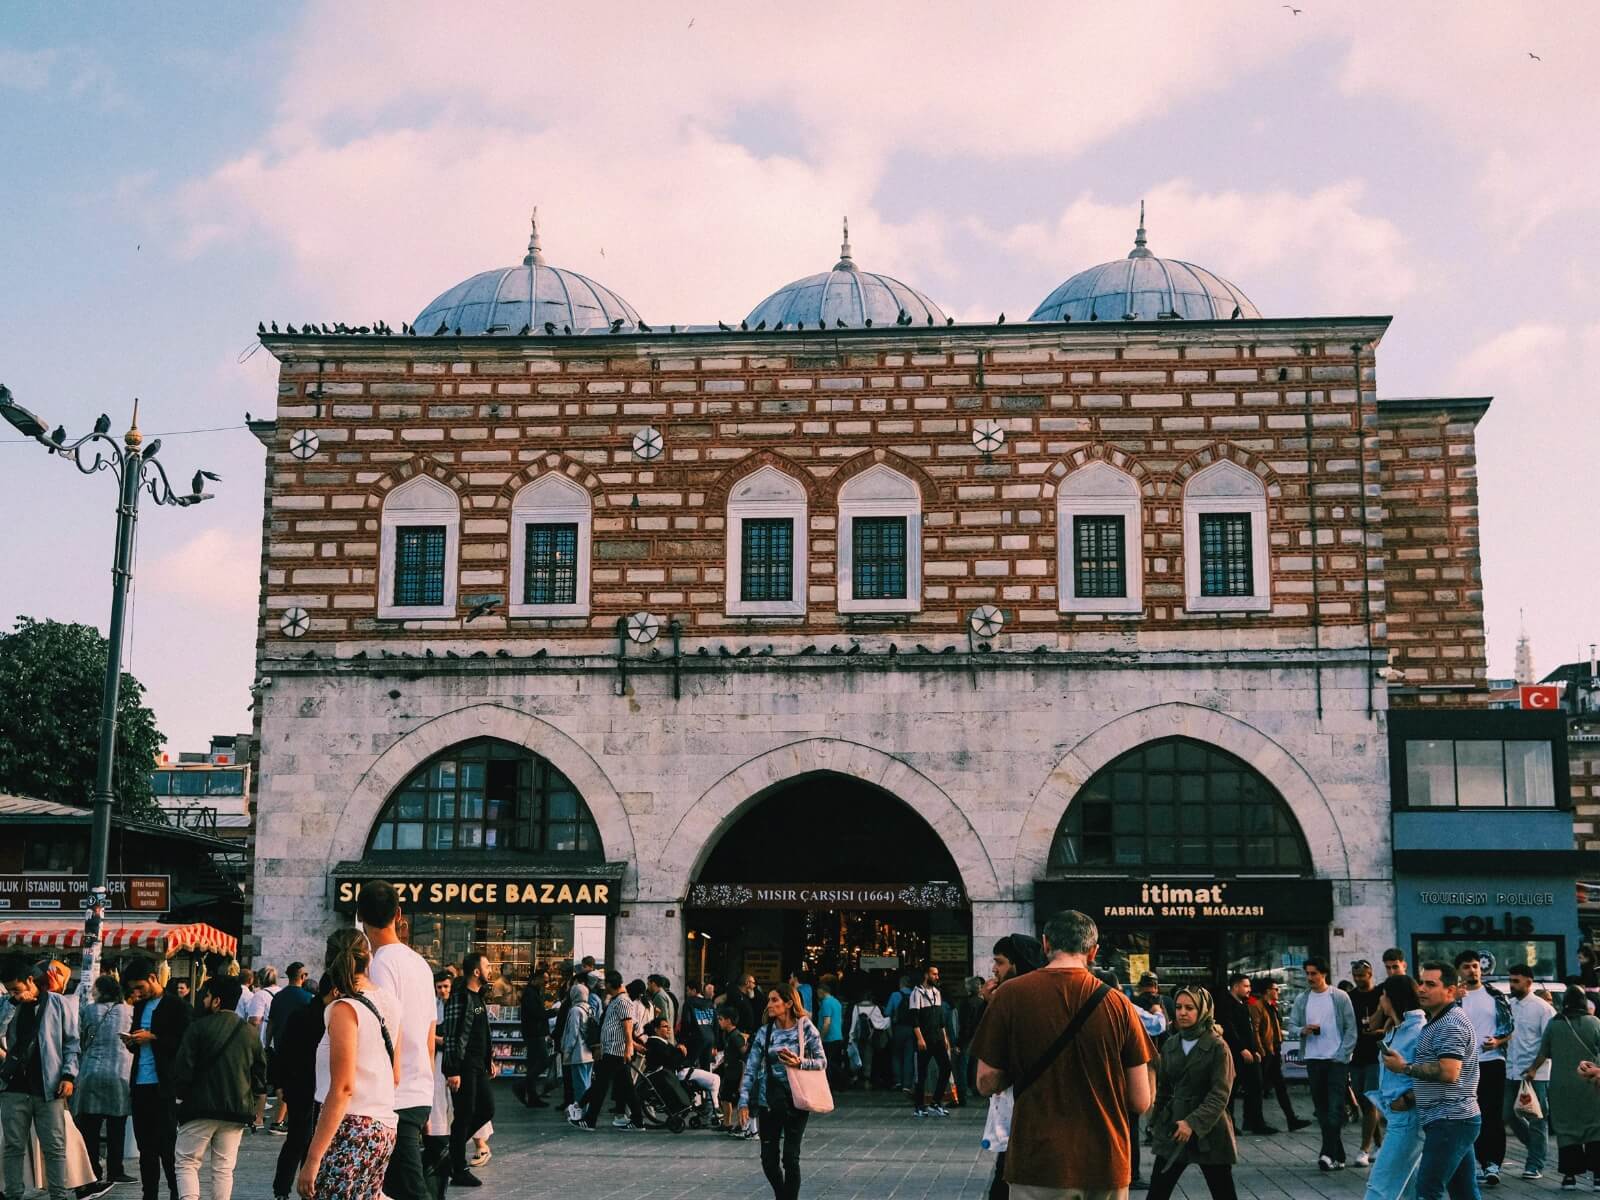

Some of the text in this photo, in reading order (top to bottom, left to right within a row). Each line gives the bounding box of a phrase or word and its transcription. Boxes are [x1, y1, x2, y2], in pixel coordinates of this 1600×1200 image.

[0, 881, 19, 892] LUK
[25, 879, 66, 892] İSTANBUL
[429, 883, 498, 903] SPICE
[505, 883, 609, 903] BAZAAR
[1141, 883, 1222, 903] itimat
[757, 889, 895, 903] MISIR ÇARŞISI (1664)
[1420, 891, 1554, 905] TOURISM POLICE
[1104, 904, 1264, 919] FABRİKA SATIŞ MAĞAZASI
[1442, 911, 1536, 935] POLİS
